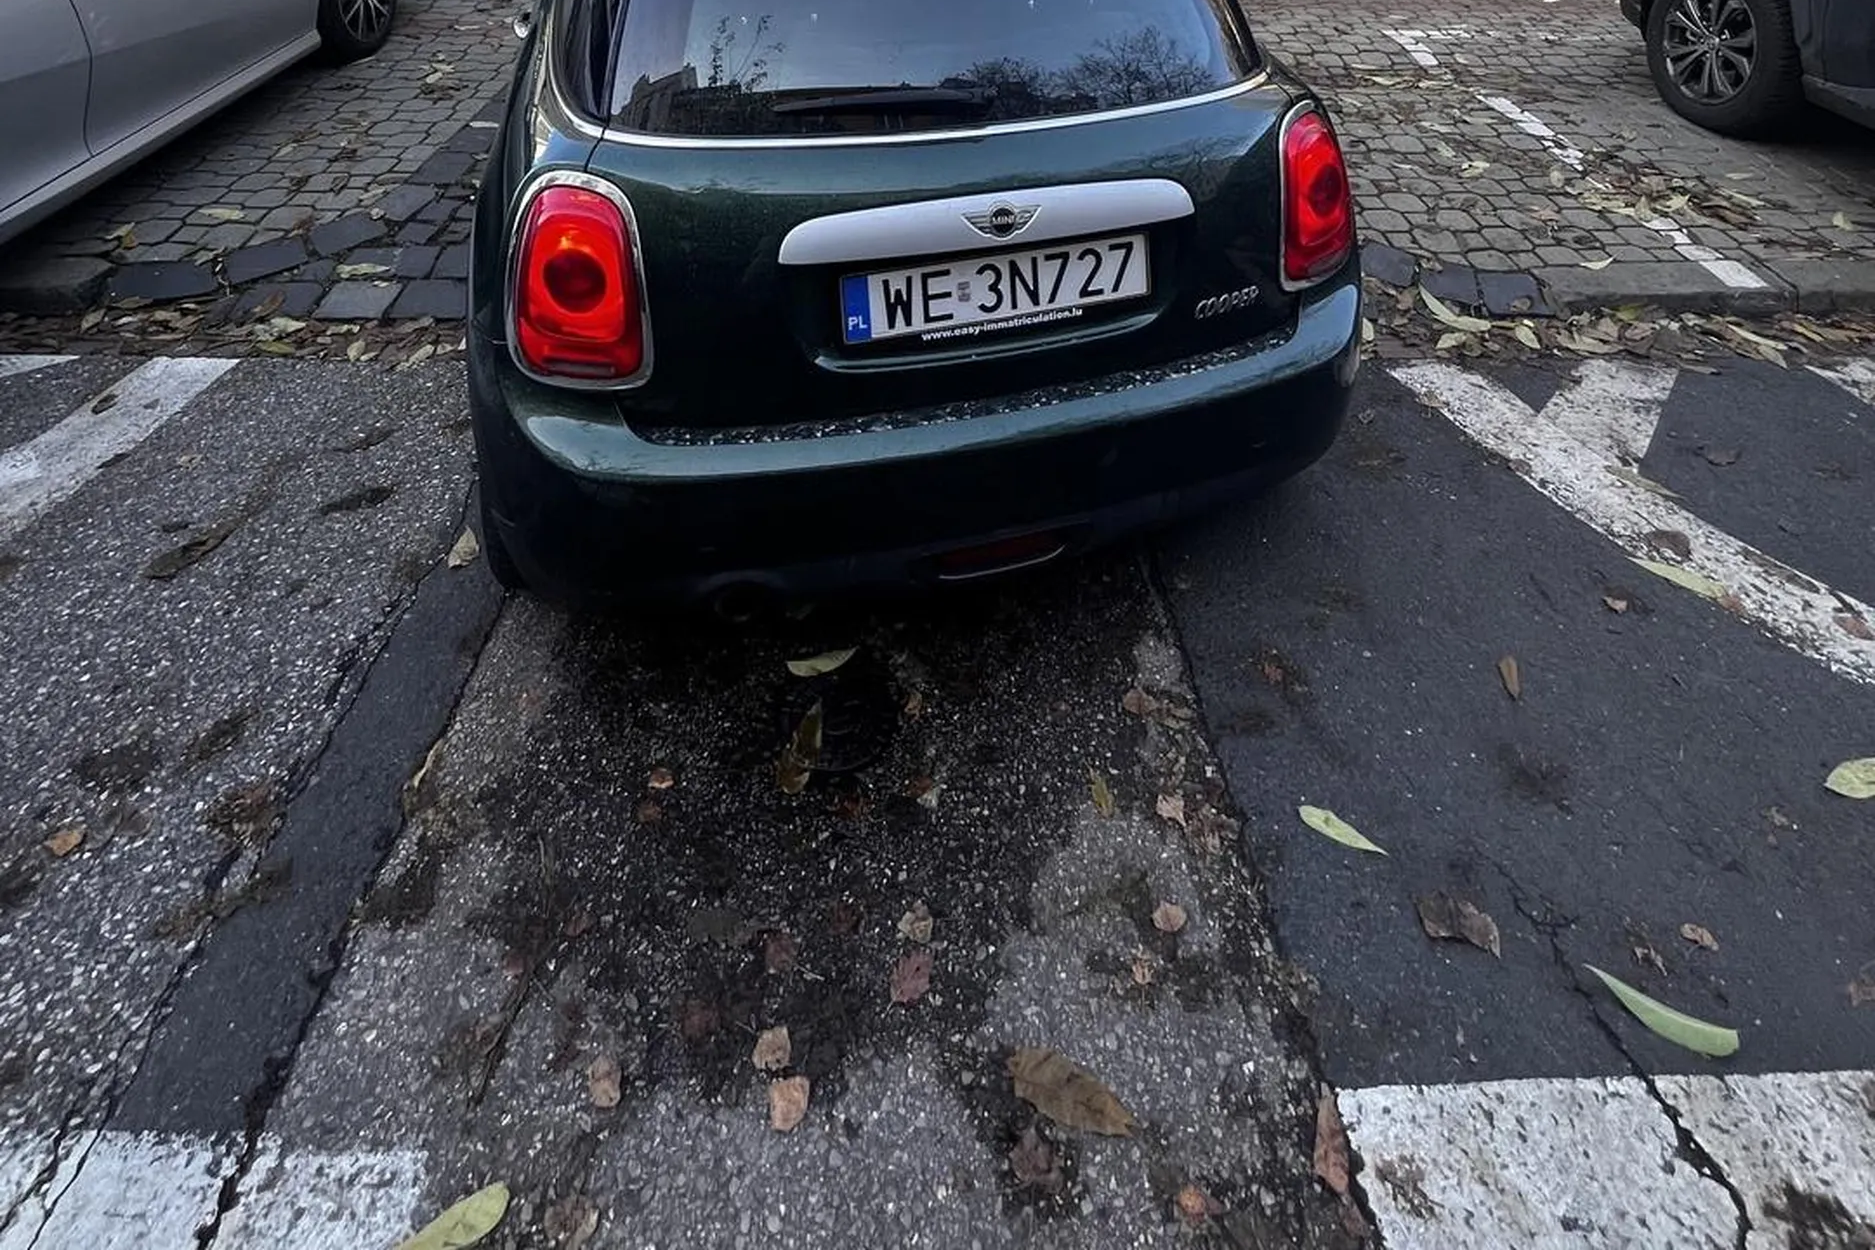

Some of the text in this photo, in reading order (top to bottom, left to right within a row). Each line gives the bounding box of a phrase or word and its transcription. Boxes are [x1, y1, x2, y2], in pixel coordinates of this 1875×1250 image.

[991, 215, 1015, 225] MINI
[882, 241, 1134, 330] WE 3N727
[1194, 285, 1259, 320] COOPER
[848, 316, 867, 331] PL
[922, 307, 1083, 342] www.easy-immatriculation.lu
